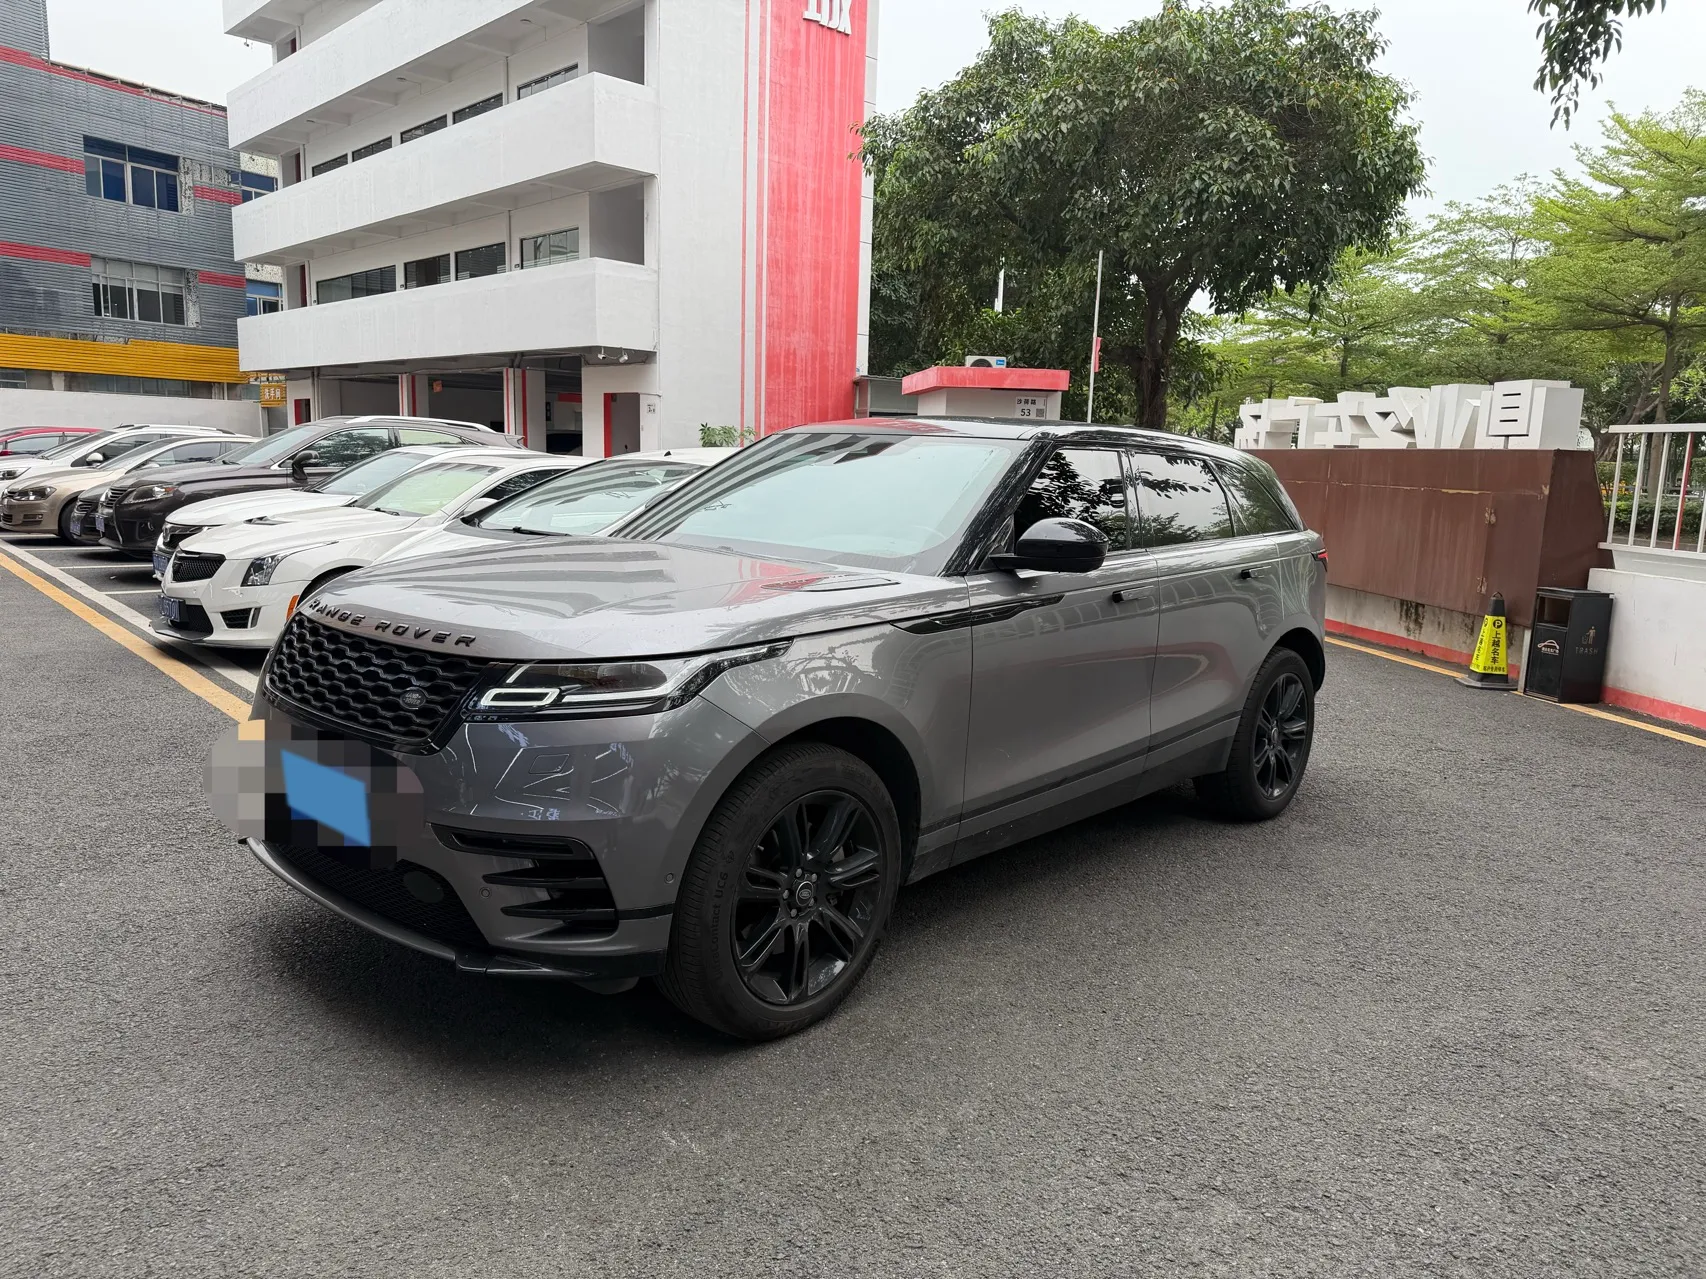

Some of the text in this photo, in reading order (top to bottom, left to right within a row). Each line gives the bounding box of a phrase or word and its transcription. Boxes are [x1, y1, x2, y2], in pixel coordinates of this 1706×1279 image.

[1020, 408, 1031, 417] 53
[308, 599, 477, 647] RANGE ROVER
[1490, 630, 1501, 665] 上越名车
[1575, 646, 1599, 655] TRASH
[713, 871, 728, 899] UC6
